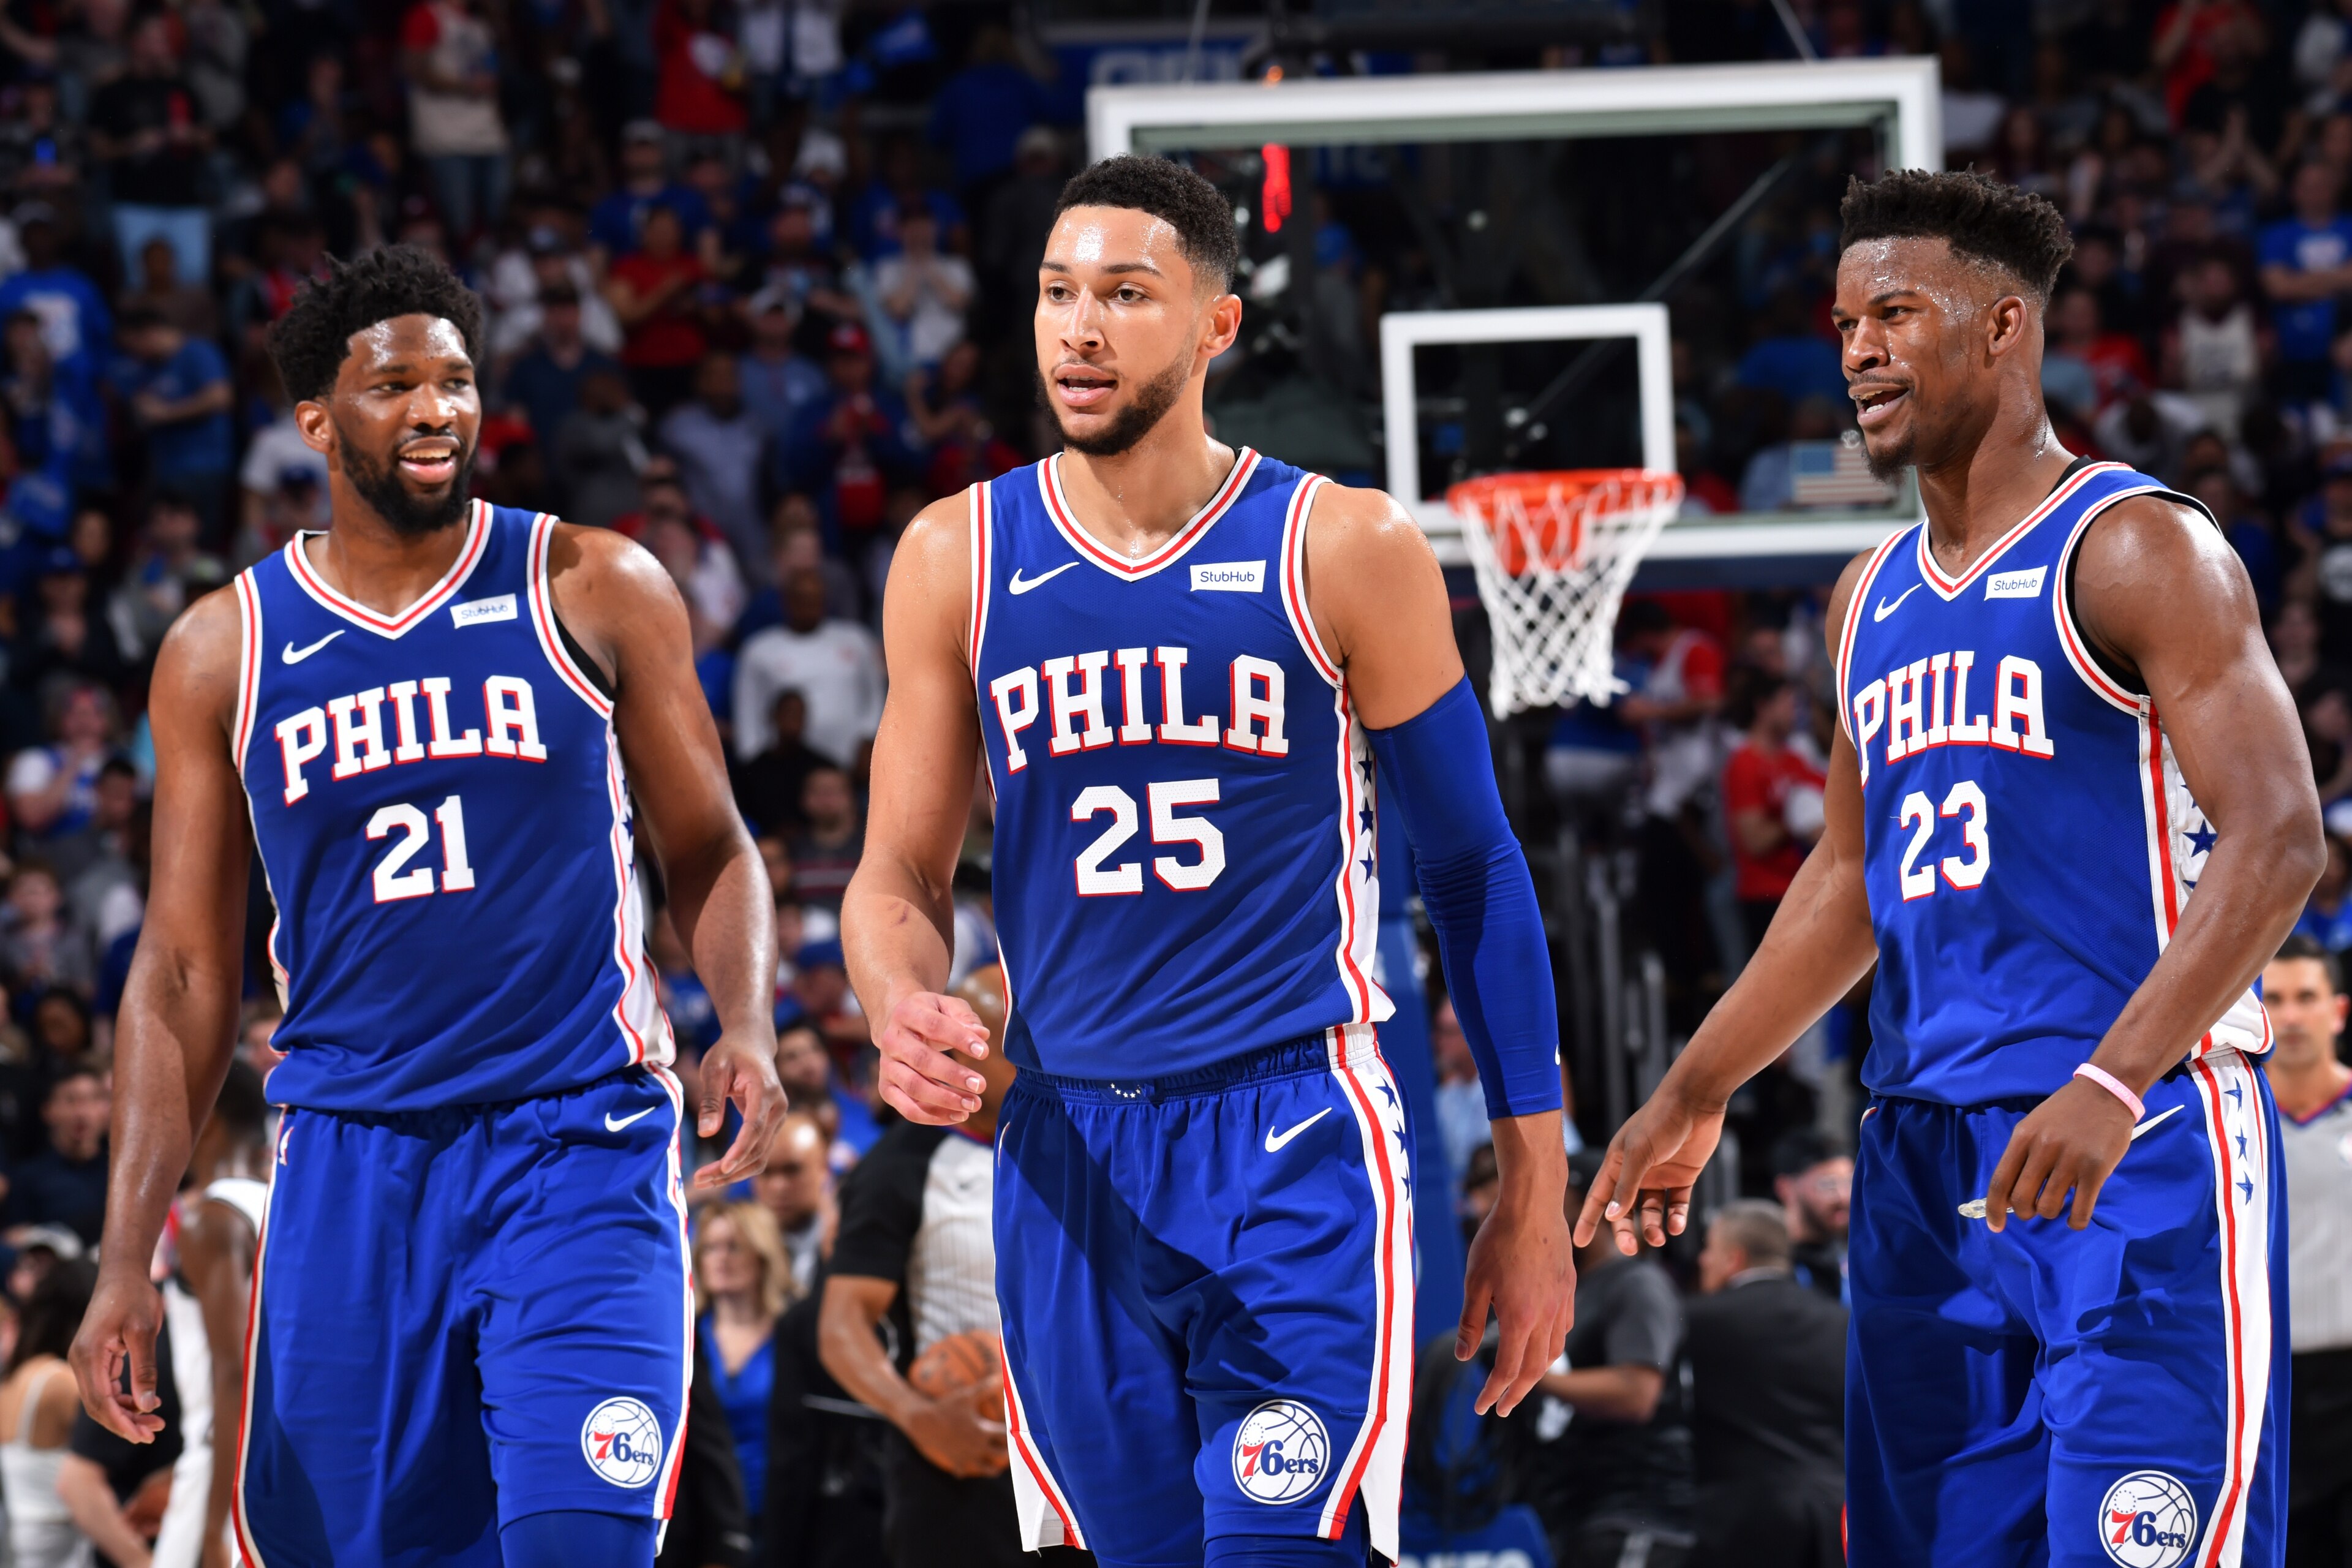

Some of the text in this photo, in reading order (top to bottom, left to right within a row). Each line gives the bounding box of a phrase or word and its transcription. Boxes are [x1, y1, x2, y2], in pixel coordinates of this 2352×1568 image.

[461, 604, 508, 619] StubHub
[1200, 571, 1254, 582] StubHub
[1994, 578, 2037, 591] StubHub
[274, 676, 547, 806] PHILA
[989, 646, 1289, 775] PHILA
[1853, 650, 2054, 791] PHILA
[365, 795, 475, 904] 21
[1070, 778, 1226, 897] 25
[1899, 780, 1991, 903] 23
[594, 1430, 654, 1466] 76ers
[1242, 1439, 1319, 1478] 76ers
[2111, 1509, 2185, 1548] 76ers
